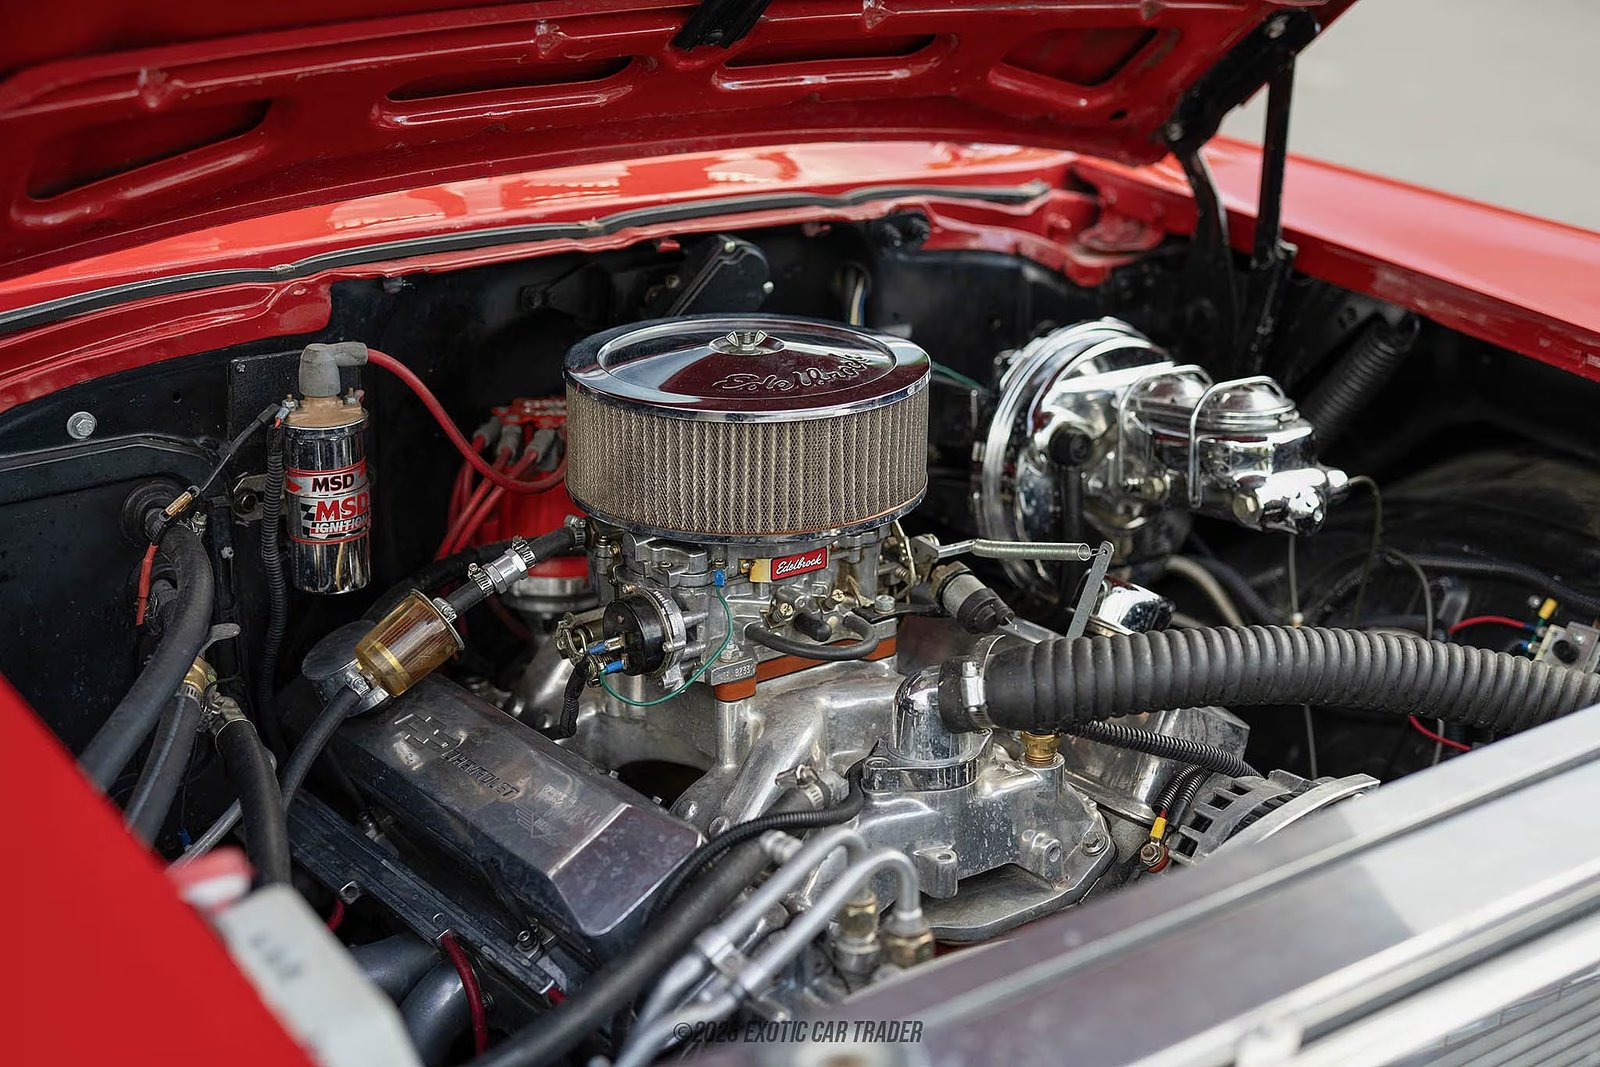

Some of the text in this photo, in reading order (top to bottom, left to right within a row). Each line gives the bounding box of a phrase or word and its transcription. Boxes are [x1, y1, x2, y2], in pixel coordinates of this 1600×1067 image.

[312, 474, 354, 493] MSD
[315, 493, 369, 521] MSD
[776, 553, 822, 575] Edelbrock
[441, 750, 520, 797] CHEVROLET
